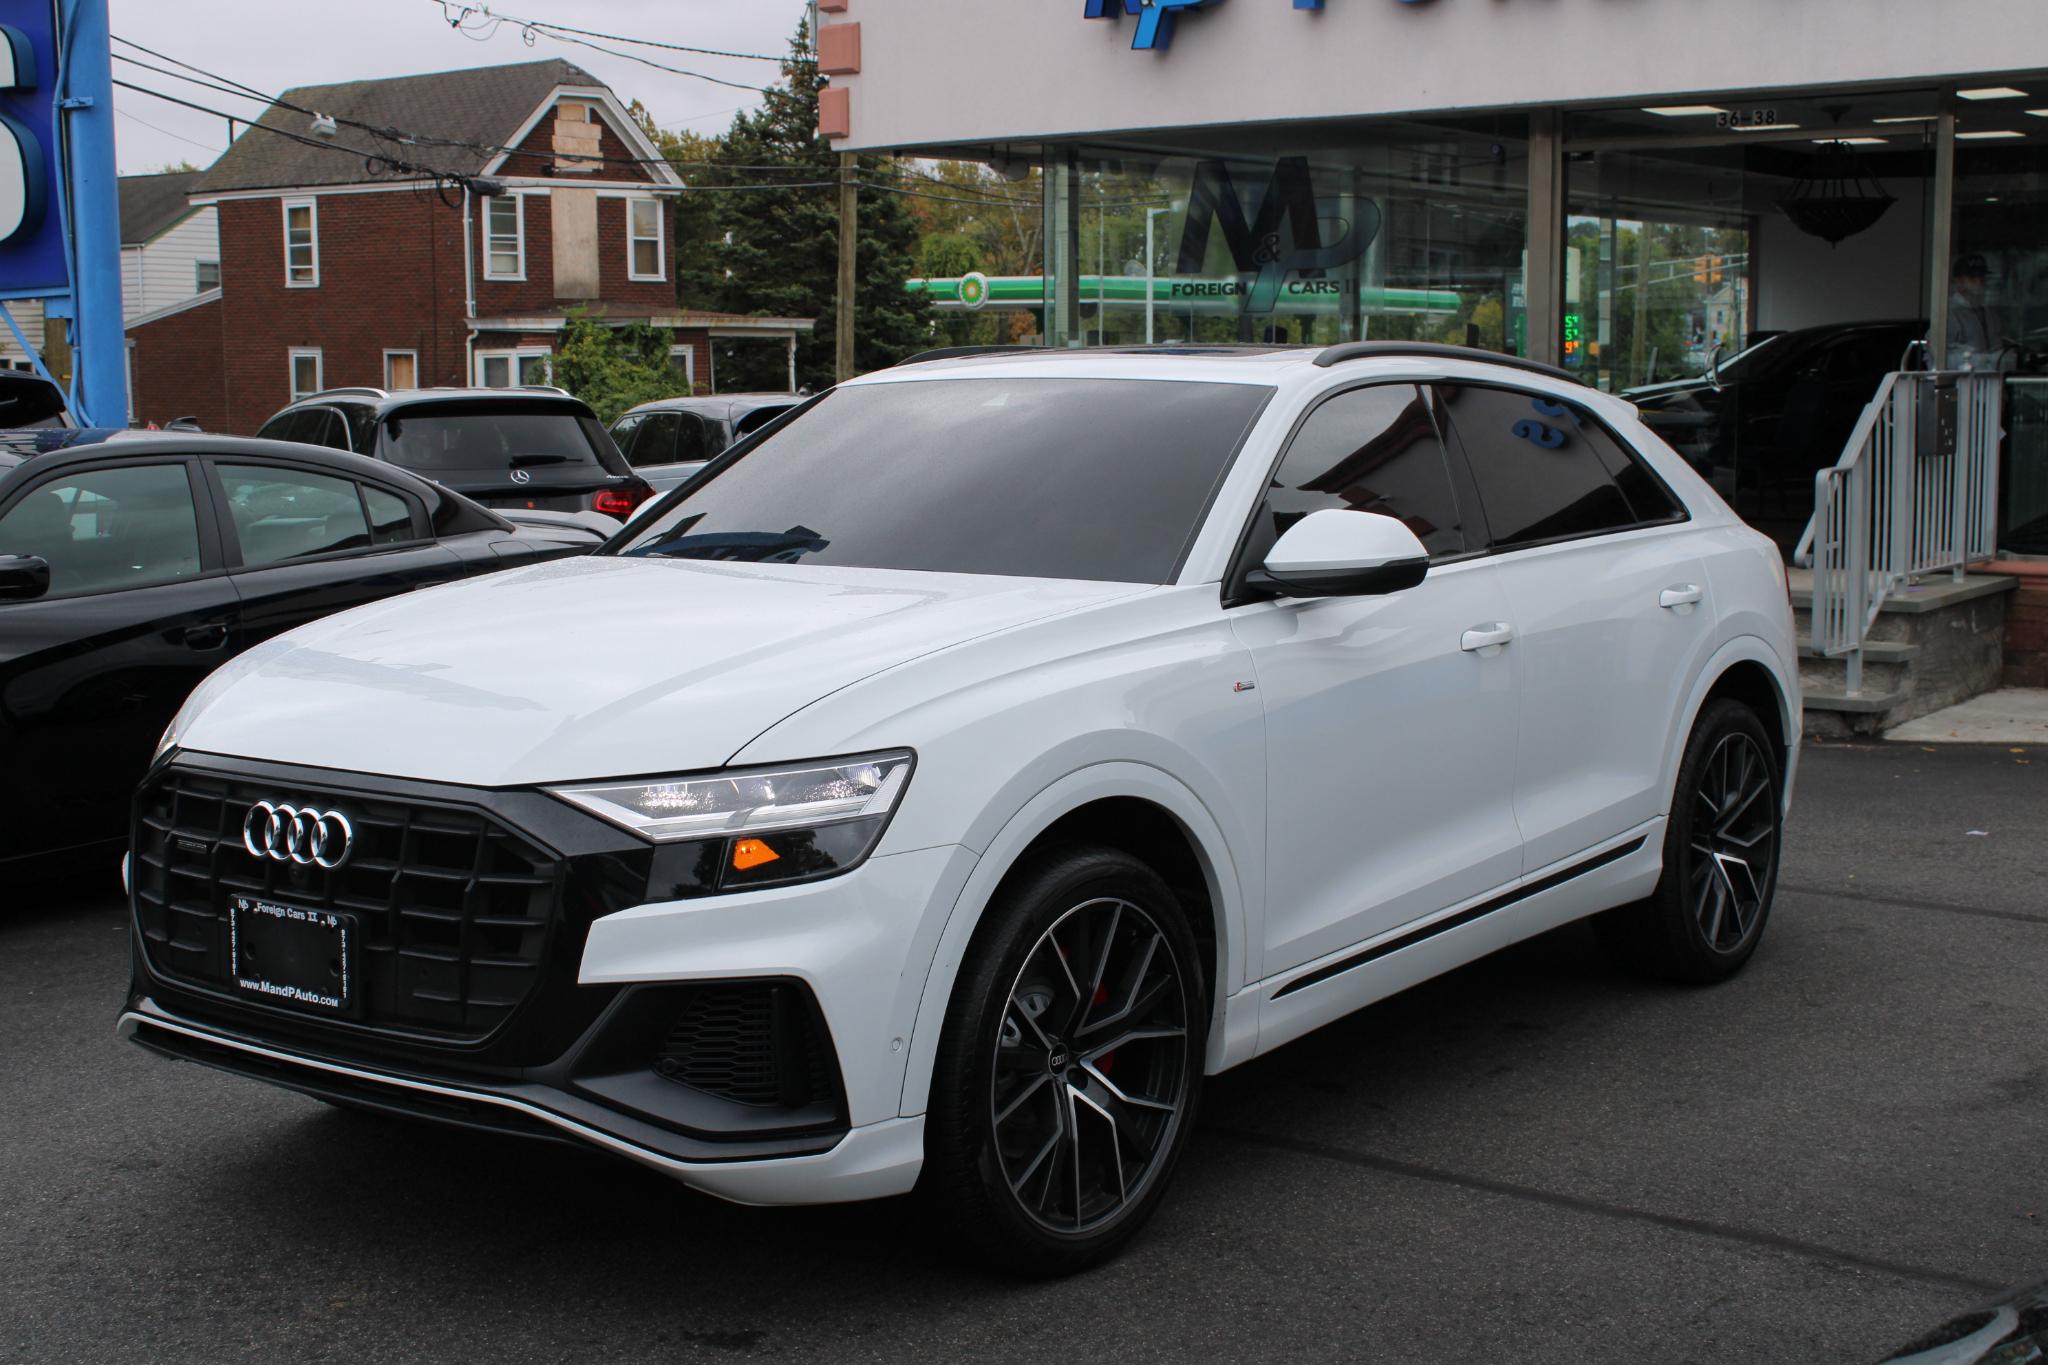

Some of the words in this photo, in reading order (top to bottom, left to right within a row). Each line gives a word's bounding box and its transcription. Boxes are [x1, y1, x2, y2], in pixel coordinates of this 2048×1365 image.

[1718, 110, 1775, 126] 36-38
[1172, 283, 1247, 296] FOREIGN
[1288, 281, 1340, 294] CARS
[257, 902, 286, 918] Foreign
[286, 908, 305, 920] Cars
